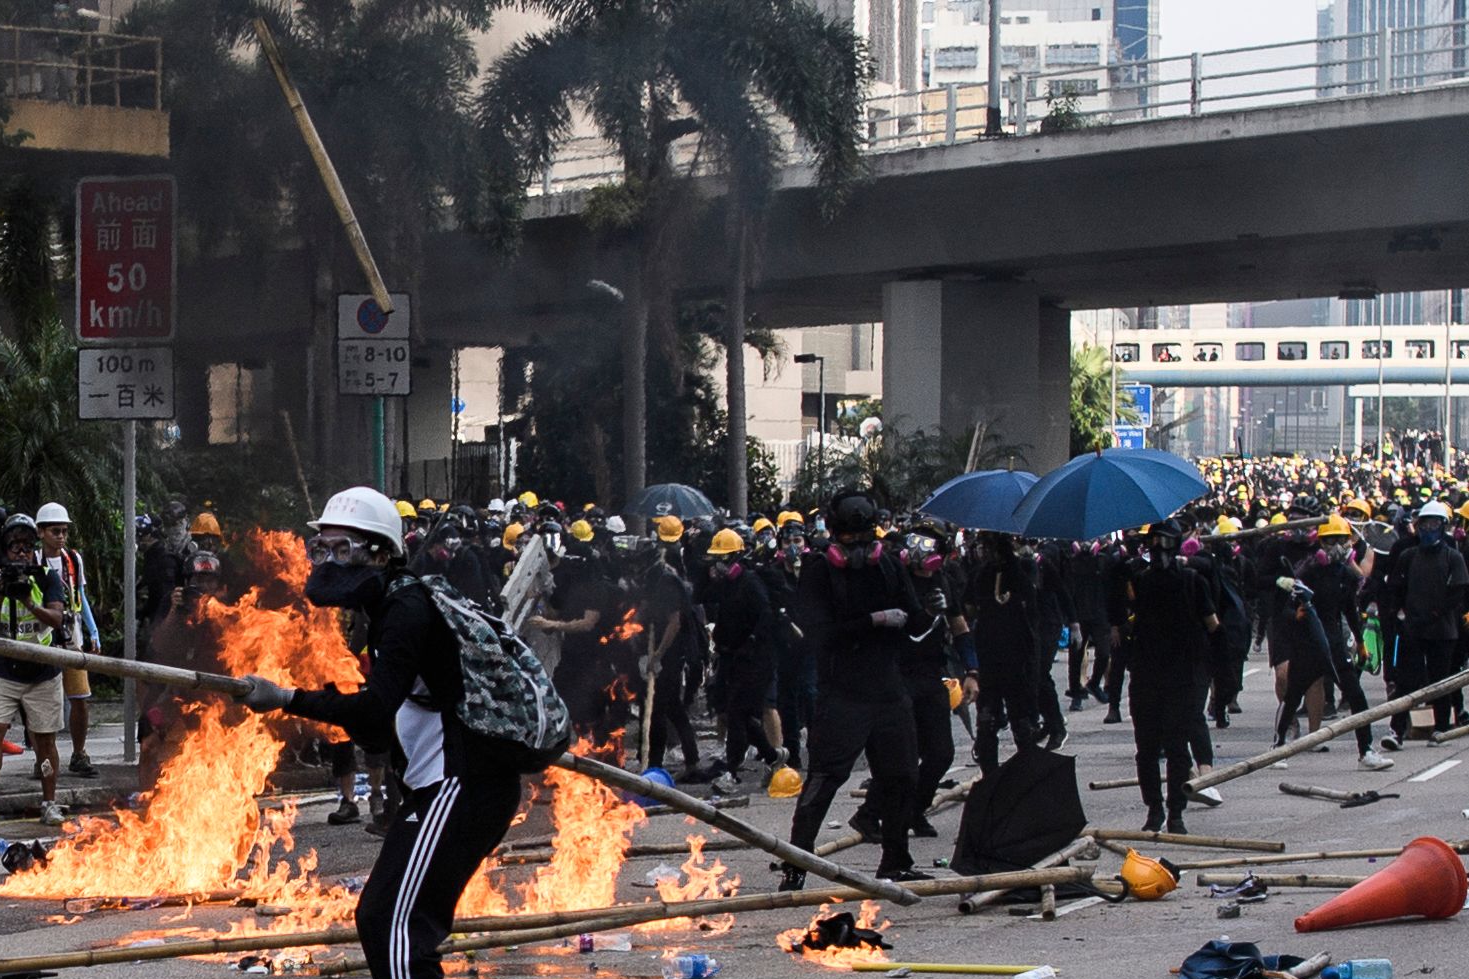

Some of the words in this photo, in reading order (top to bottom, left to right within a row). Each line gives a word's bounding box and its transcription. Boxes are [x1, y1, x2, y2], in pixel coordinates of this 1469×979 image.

[92, 191, 163, 213] Ahead
[96, 218, 157, 251] 前面
[107, 262, 147, 292] 50
[90, 299, 163, 327] km/h
[97, 356, 133, 373] 100
[138, 359, 156, 373] m
[364, 347, 407, 362] 8-10
[364, 372, 399, 389] 5-7
[88, 383, 165, 408] 一百米
